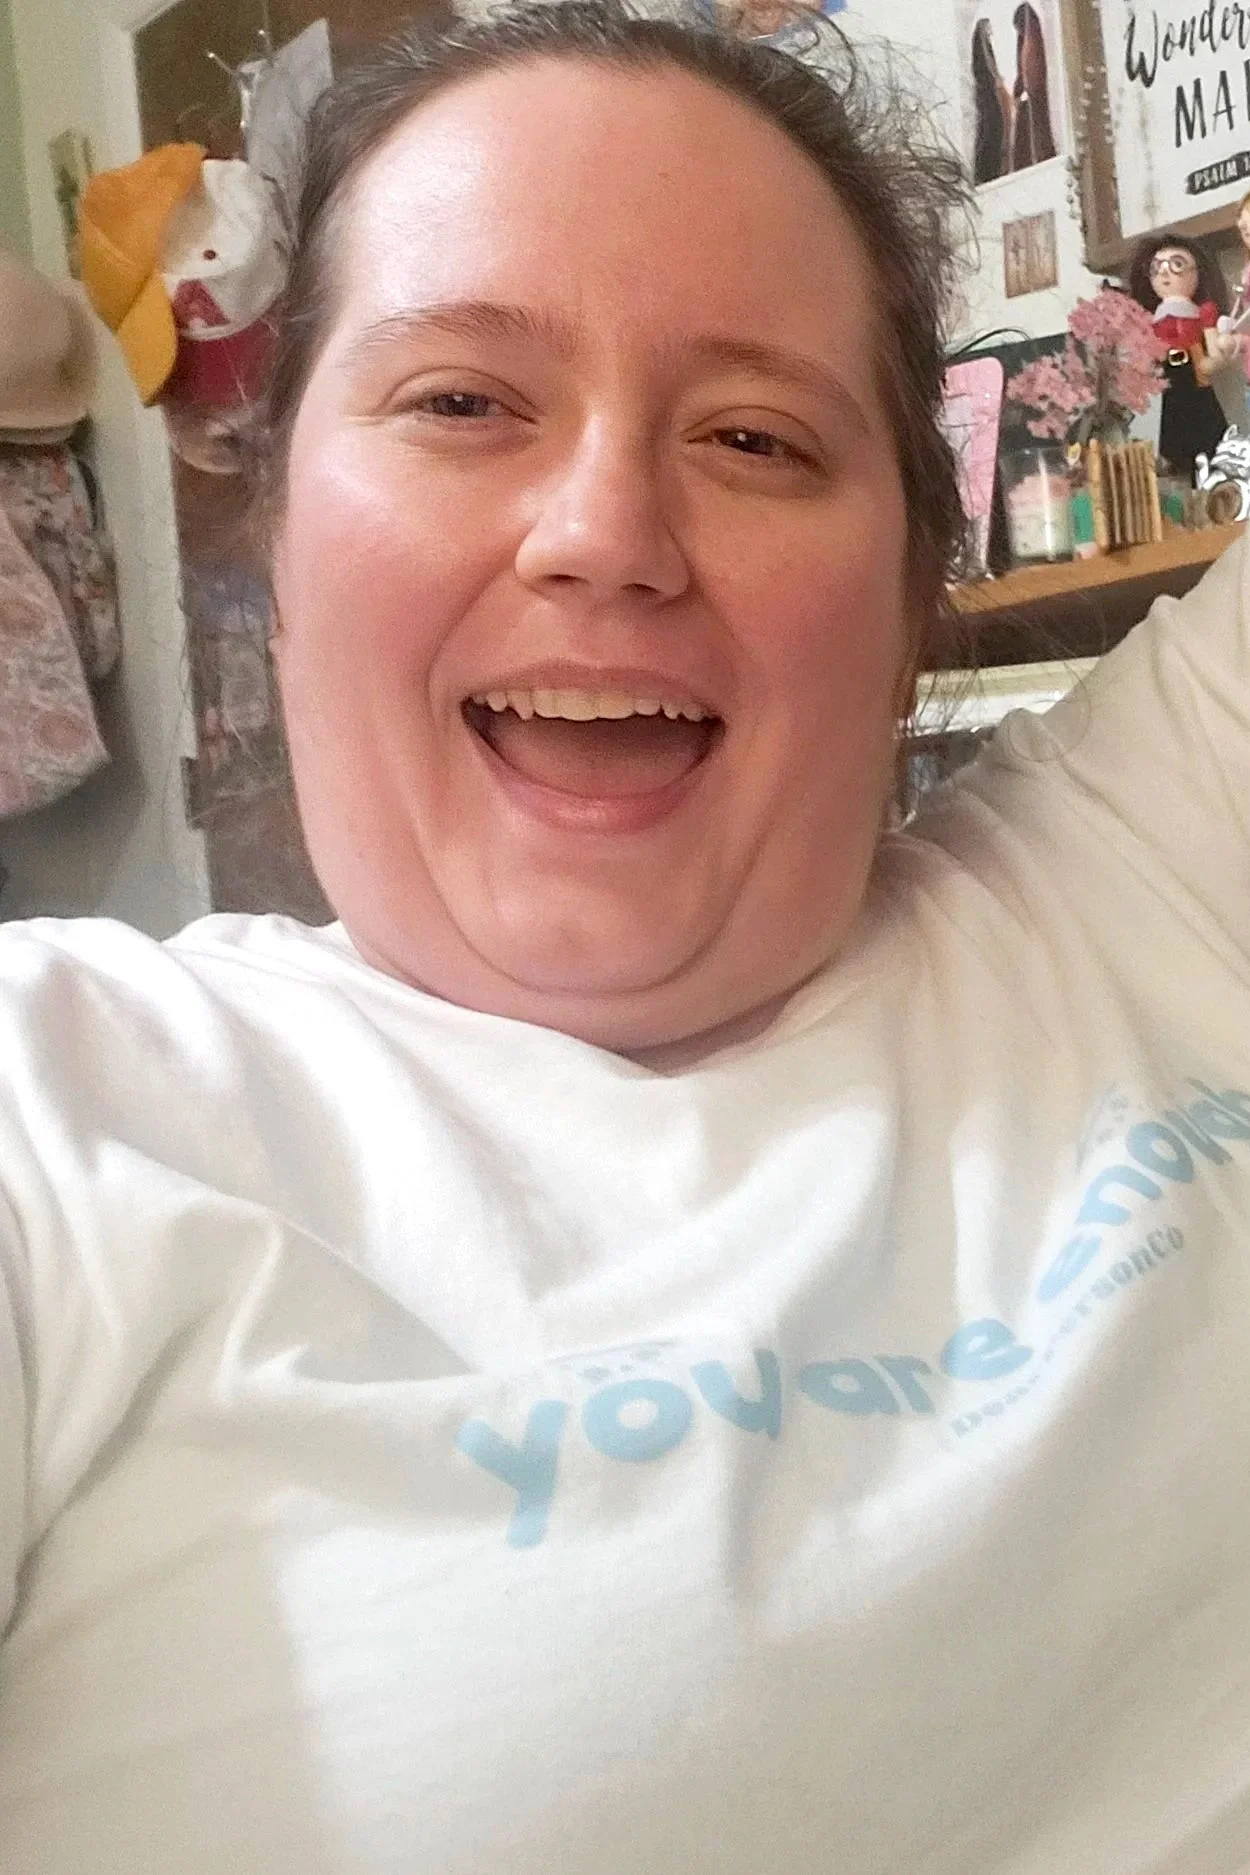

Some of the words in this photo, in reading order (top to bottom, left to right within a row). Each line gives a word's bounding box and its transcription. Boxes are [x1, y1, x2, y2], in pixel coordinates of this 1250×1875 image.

[1193, 158, 1238, 191] PSALM
[454, 1346, 782, 1550] you
[796, 1317, 1035, 1417] are
